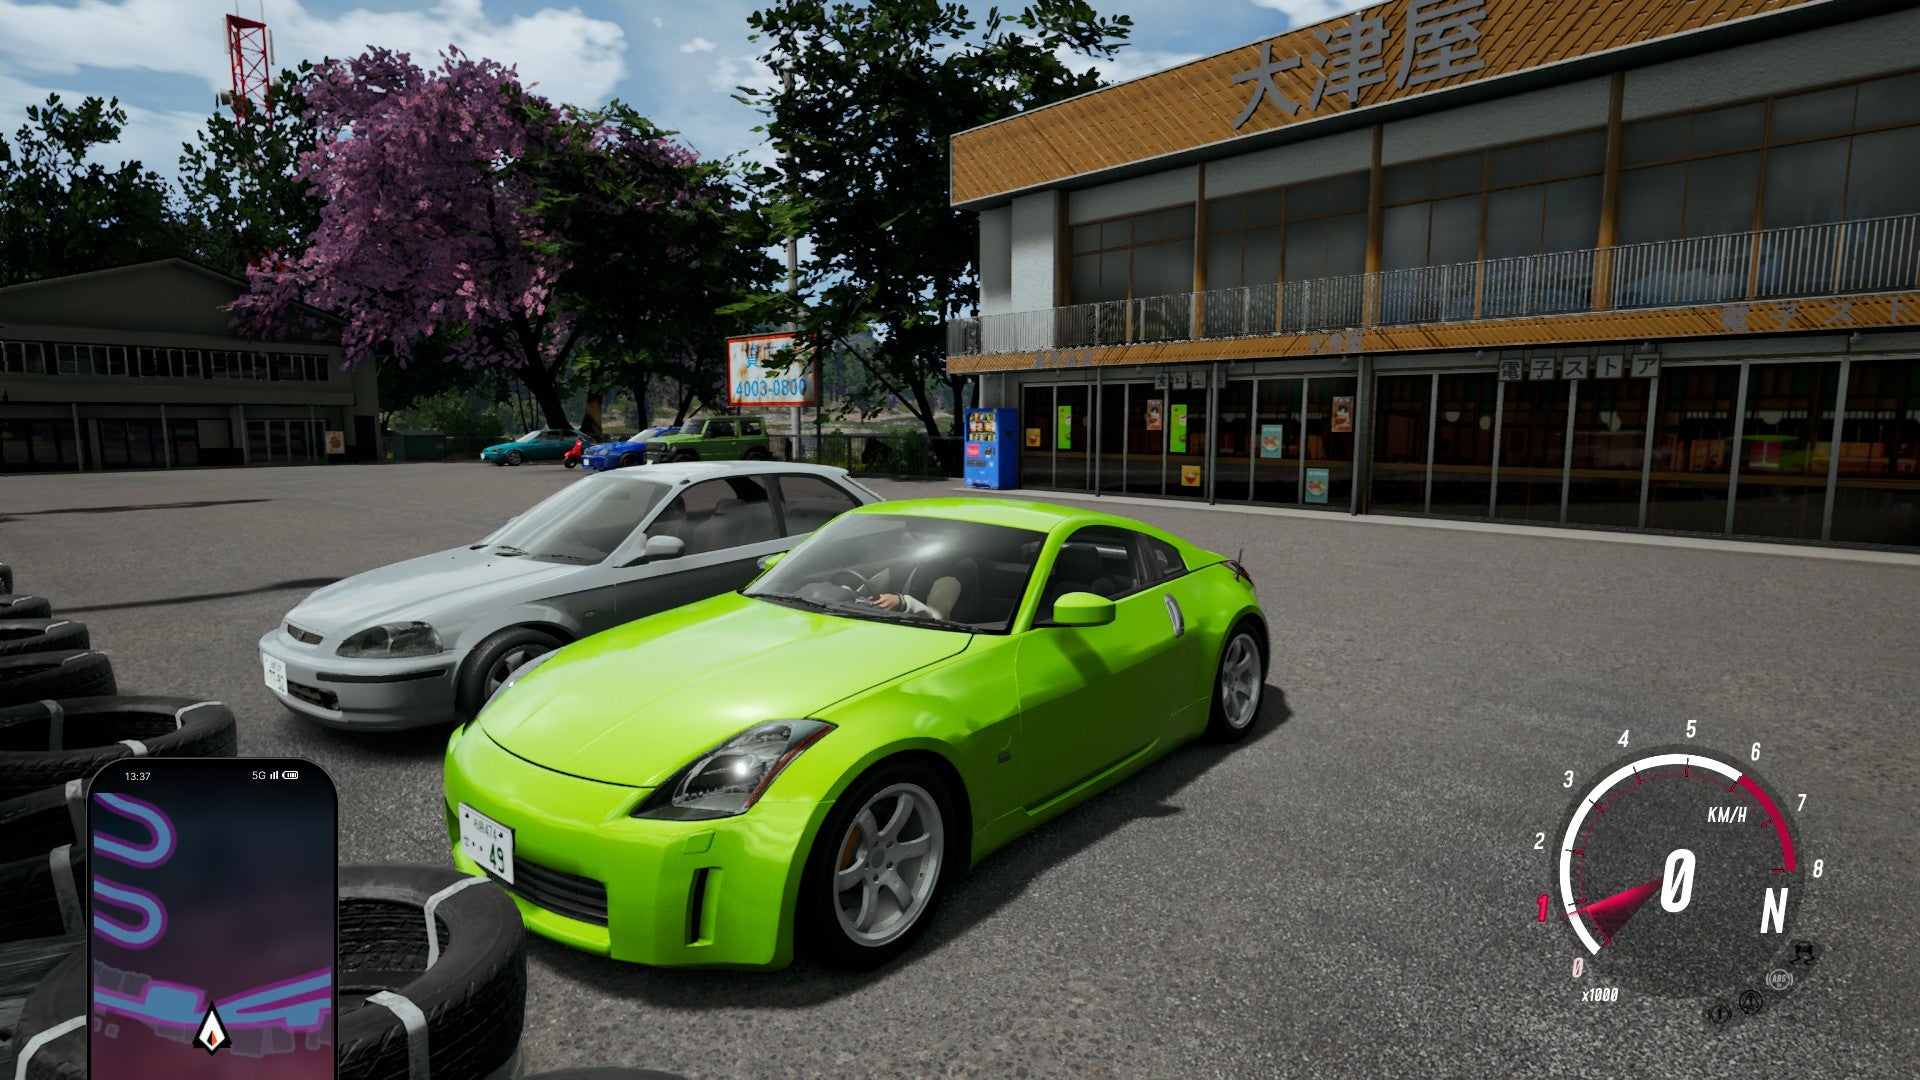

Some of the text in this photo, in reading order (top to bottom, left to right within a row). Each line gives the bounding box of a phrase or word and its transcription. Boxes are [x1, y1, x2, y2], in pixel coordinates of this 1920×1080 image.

[1231, 0, 1487, 130] 大津屋
[1501, 357, 1658, 380] 電子ストア
[735, 378, 808, 398] 4003-0800
[125, 772, 151, 781] 13:37
[252, 770, 266, 780] 5G
